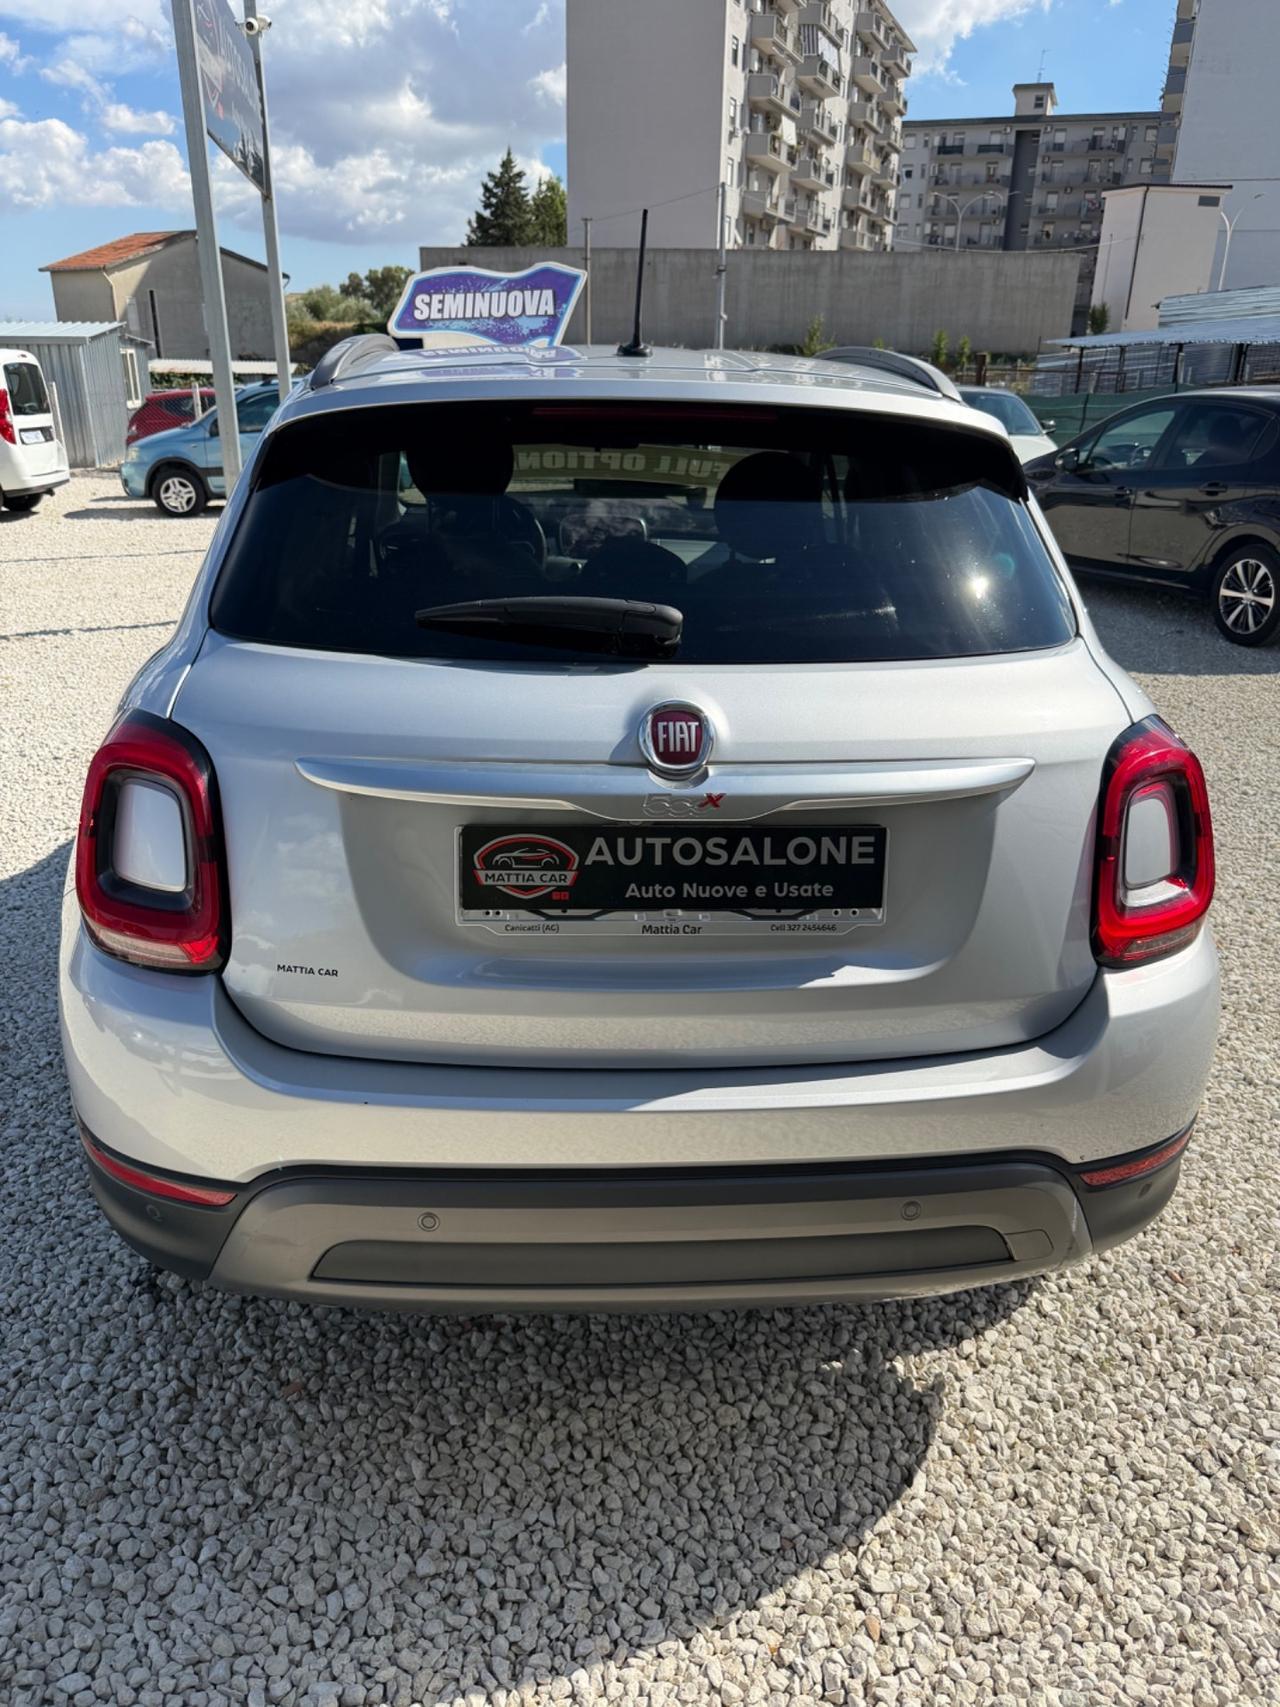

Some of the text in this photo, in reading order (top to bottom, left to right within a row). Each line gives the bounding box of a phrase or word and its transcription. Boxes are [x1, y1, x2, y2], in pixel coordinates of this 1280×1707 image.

[413, 289, 555, 320] SEMINUOVA
[657, 721, 699, 752] FIAT
[584, 836, 876, 866] AUTOSALONE
[484, 873, 567, 883] MATTIA CAR
[625, 882, 834, 898] Auto Nuove e Usate
[641, 924, 702, 935] Mattia Car
[277, 964, 338, 977] MATTIA CAR
